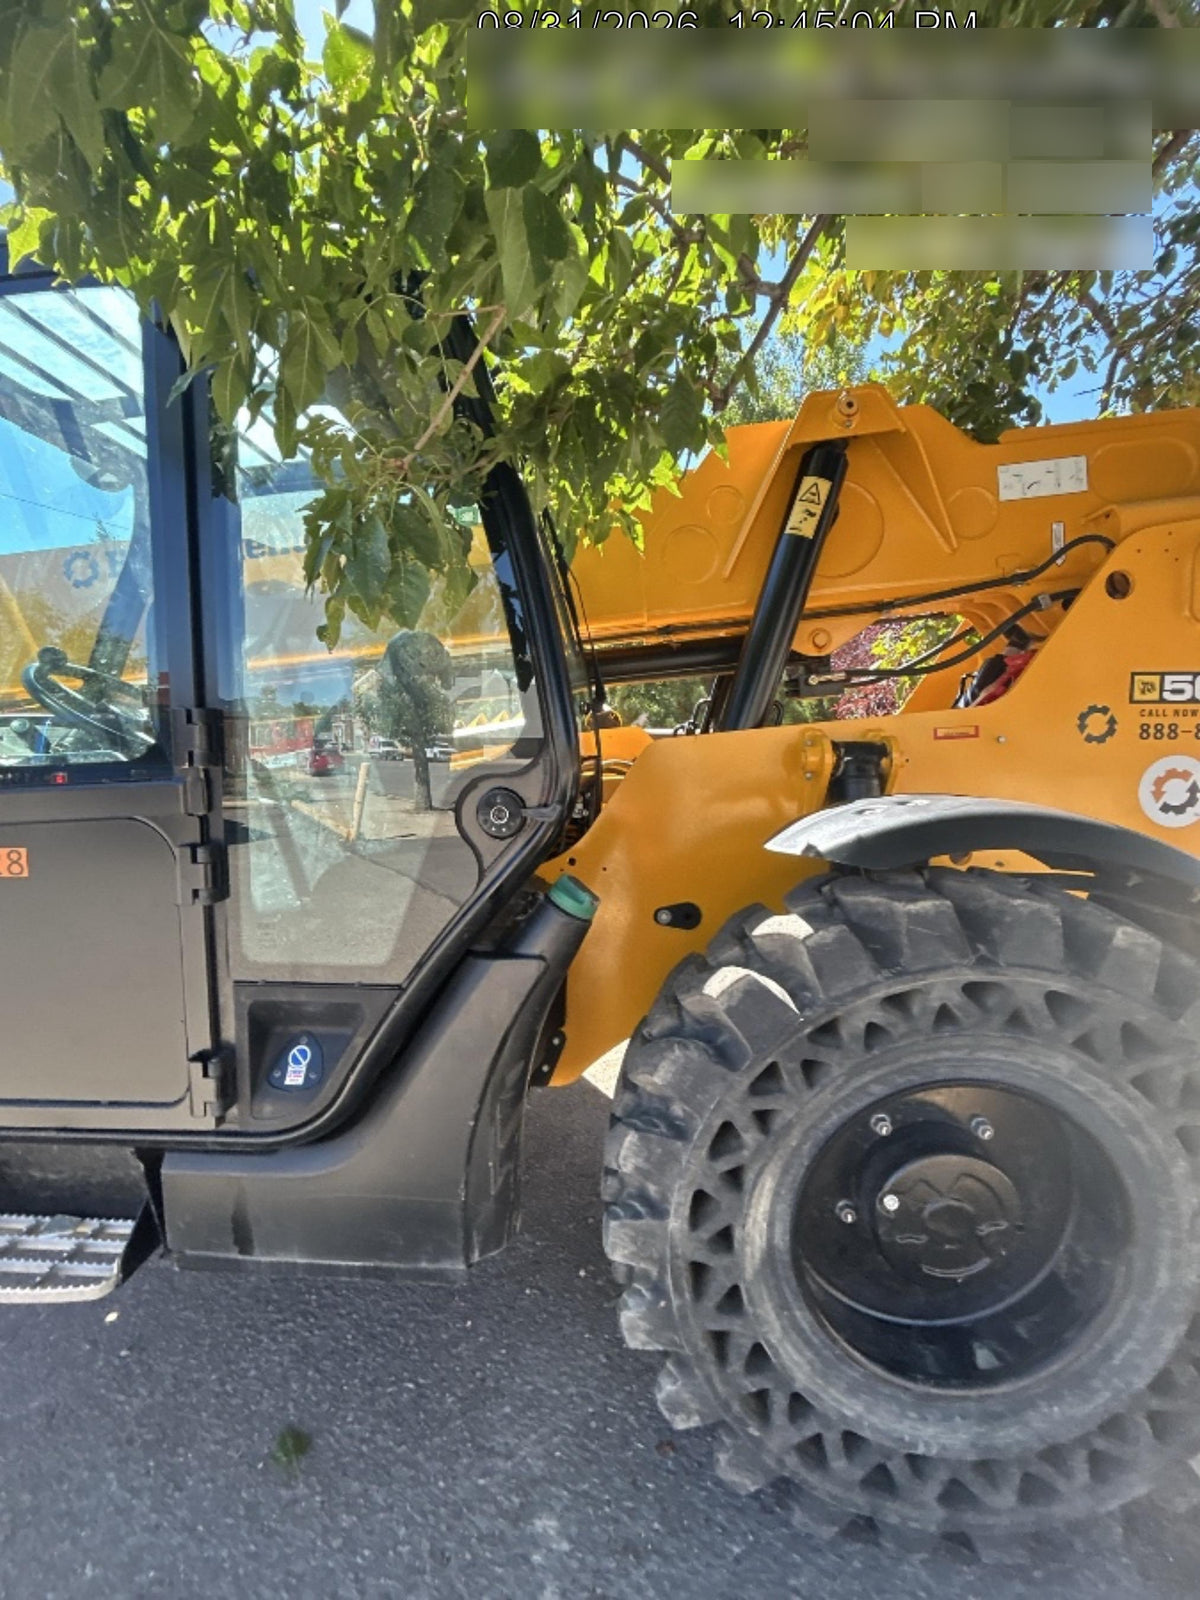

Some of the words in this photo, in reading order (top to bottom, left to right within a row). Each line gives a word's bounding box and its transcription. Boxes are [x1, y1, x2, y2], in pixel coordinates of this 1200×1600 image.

[1162, 675, 1200, 701] 5
[1139, 708, 1168, 717] CALL
[1173, 708, 1199, 717] NOW
[0, 849, 24, 875] 8
